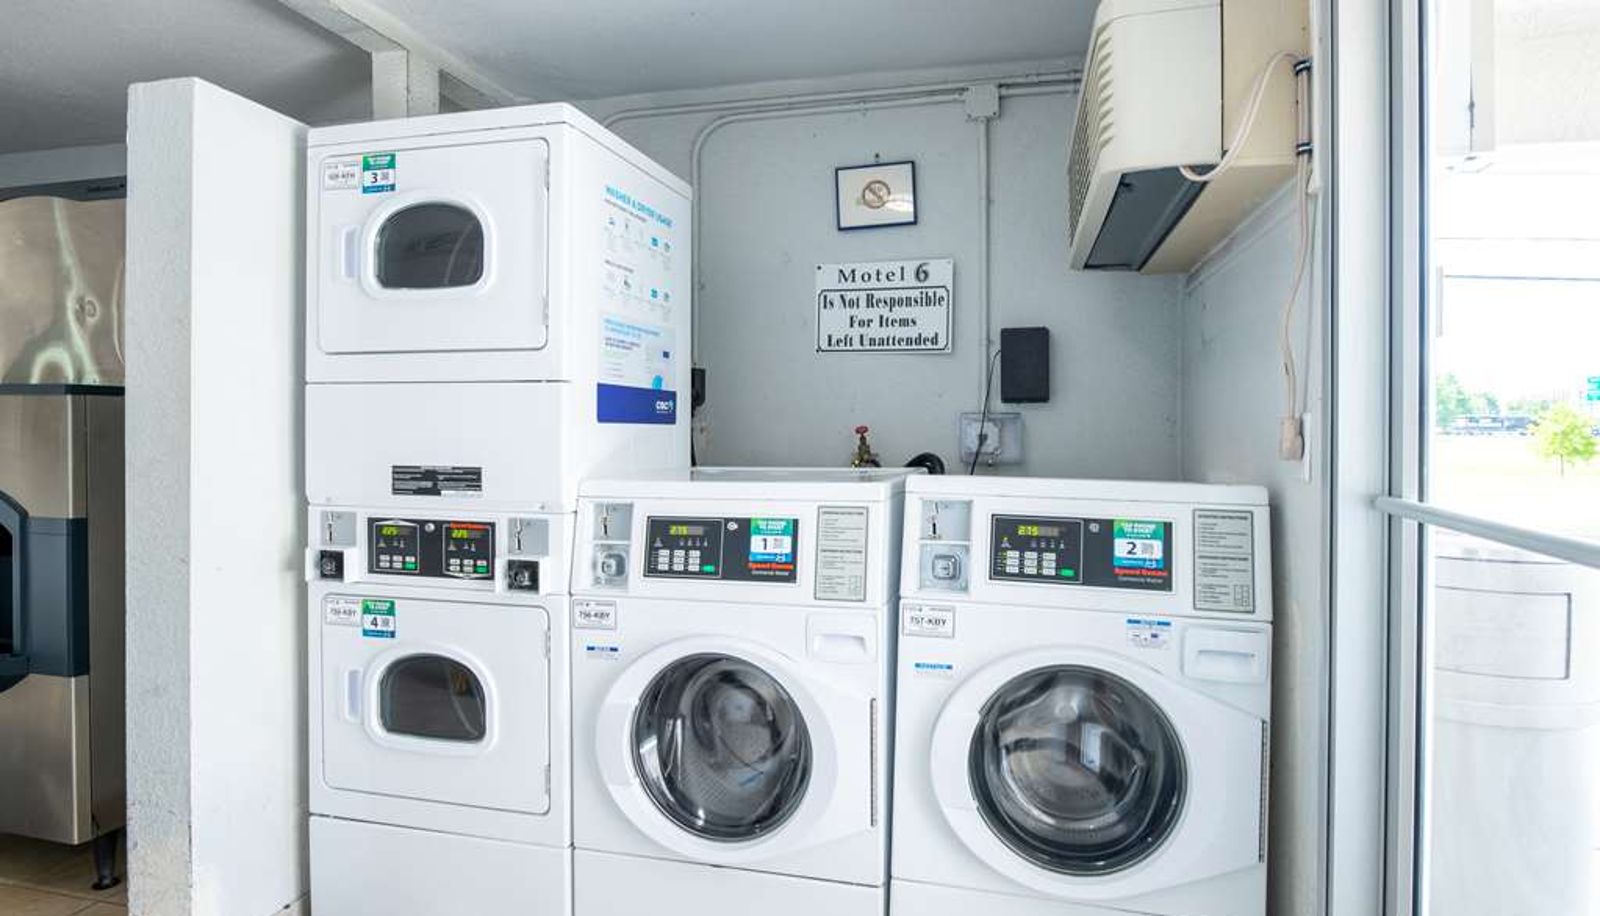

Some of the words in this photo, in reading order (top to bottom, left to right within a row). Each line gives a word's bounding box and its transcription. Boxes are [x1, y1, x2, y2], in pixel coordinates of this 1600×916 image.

[370, 172, 378, 184] 3
[838, 266, 904, 284] Motel
[914, 262, 930, 283] 6
[822, 294, 835, 310] Is
[840, 292, 860, 309] Not
[865, 291, 945, 312] Responsible
[849, 314, 873, 328] For
[878, 314, 917, 328] Items
[827, 333, 853, 347] Left
[859, 332, 938, 347] Unattended
[761, 537, 767, 551] 1
[1126, 541, 1137, 555] 2
[370, 616, 378, 629] 4
